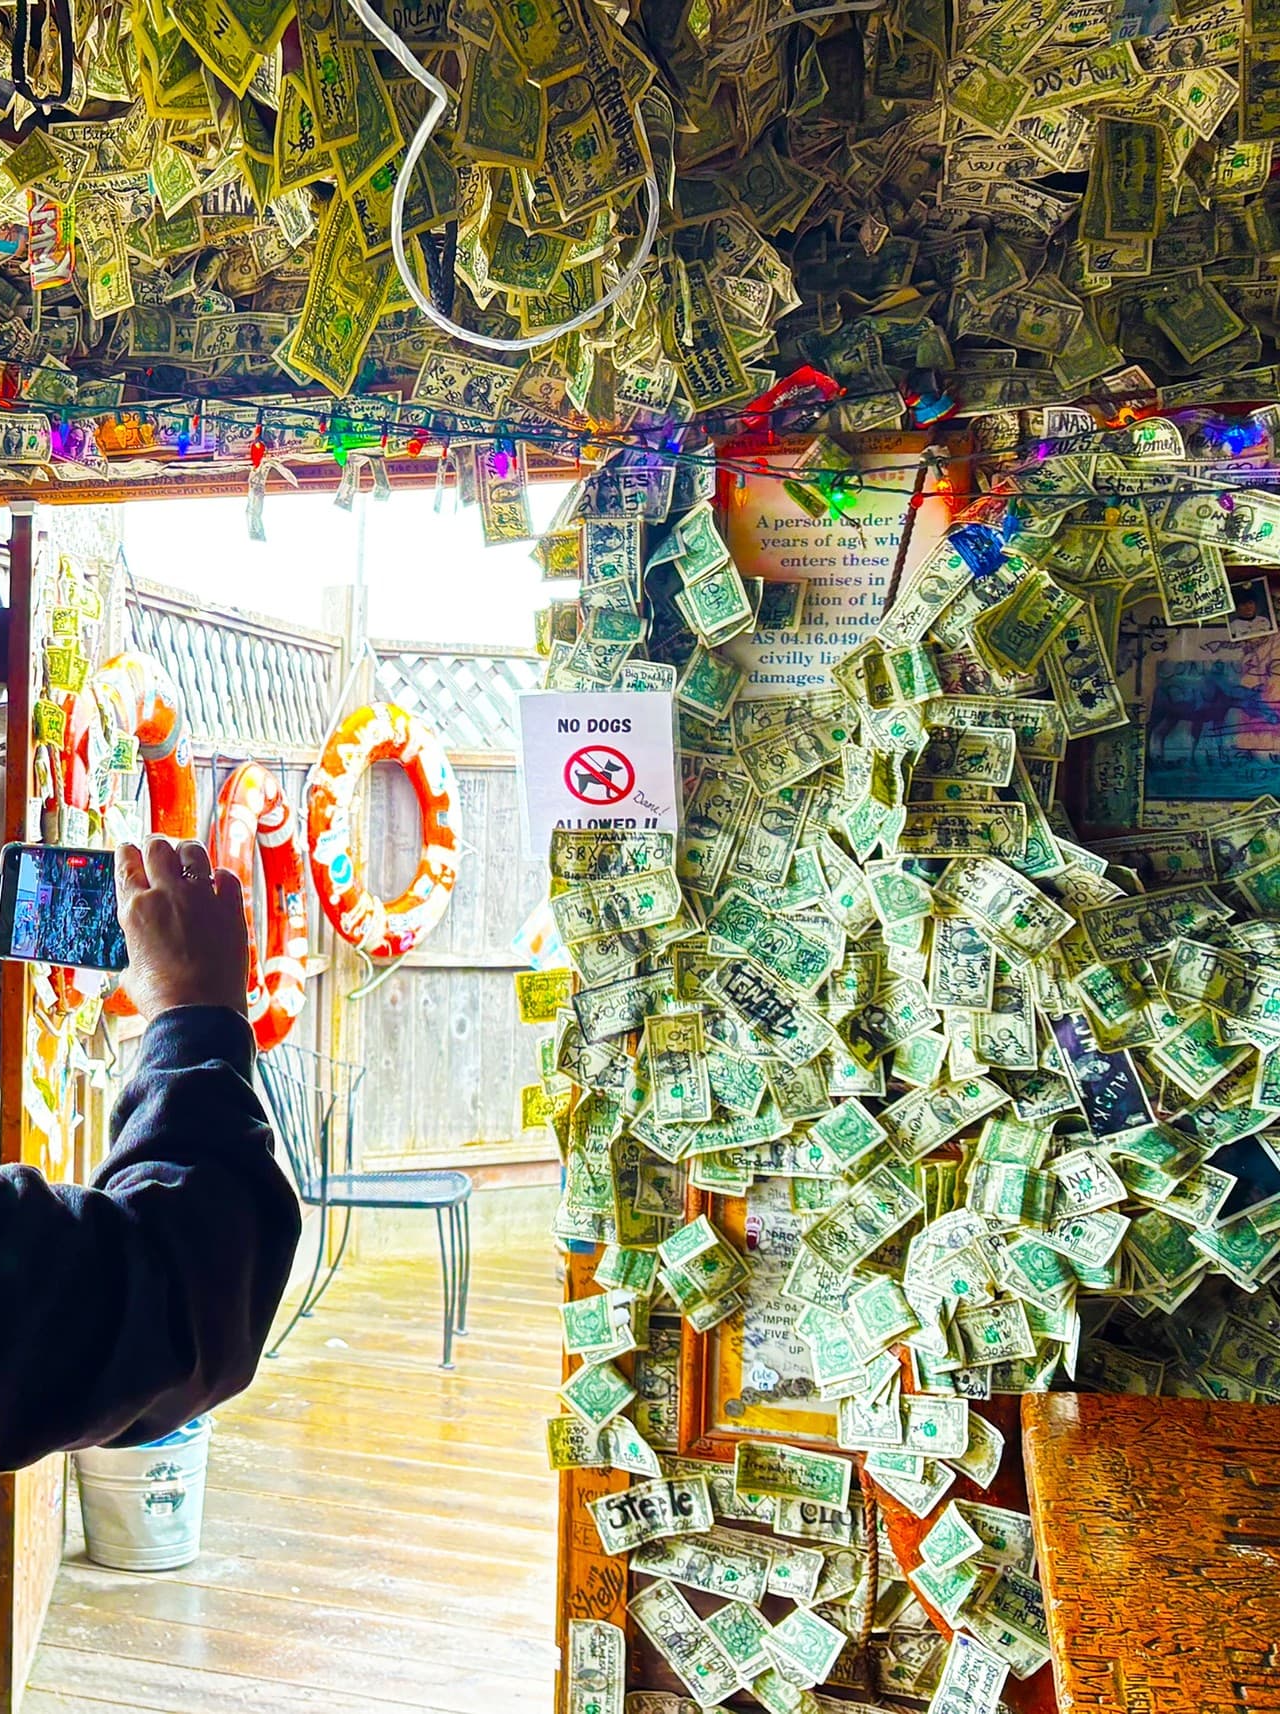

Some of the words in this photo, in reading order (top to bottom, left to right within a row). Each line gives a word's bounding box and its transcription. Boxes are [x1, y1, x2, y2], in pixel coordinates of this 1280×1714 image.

[756, 515, 769, 528] A
[774, 515, 833, 531] person
[840, 514, 893, 528] under
[898, 513, 908, 526] 2
[761, 535, 809, 550] years
[814, 533, 833, 547] of
[838, 536, 867, 550] age
[874, 532, 901, 547] wh
[780, 554, 837, 568] enters
[842, 552, 890, 567] these
[806, 573, 862, 587] emises
[869, 573, 886, 587] in
[848, 592, 868, 606] of
[872, 593, 887, 606] la
[800, 614, 830, 629] uld,
[836, 614, 880, 627] unde
[751, 631, 775, 645] AS
[759, 652, 814, 667] civilly
[820, 652, 841, 666] lia
[749, 671, 825, 687] damages
[557, 718, 580, 733] NO
[587, 718, 632, 733] DOGS
[555, 817, 637, 829] ALLOWED
[766, 1302, 781, 1311] AS
[764, 1329, 790, 1340] FIVE
[789, 1345, 804, 1355] UP
